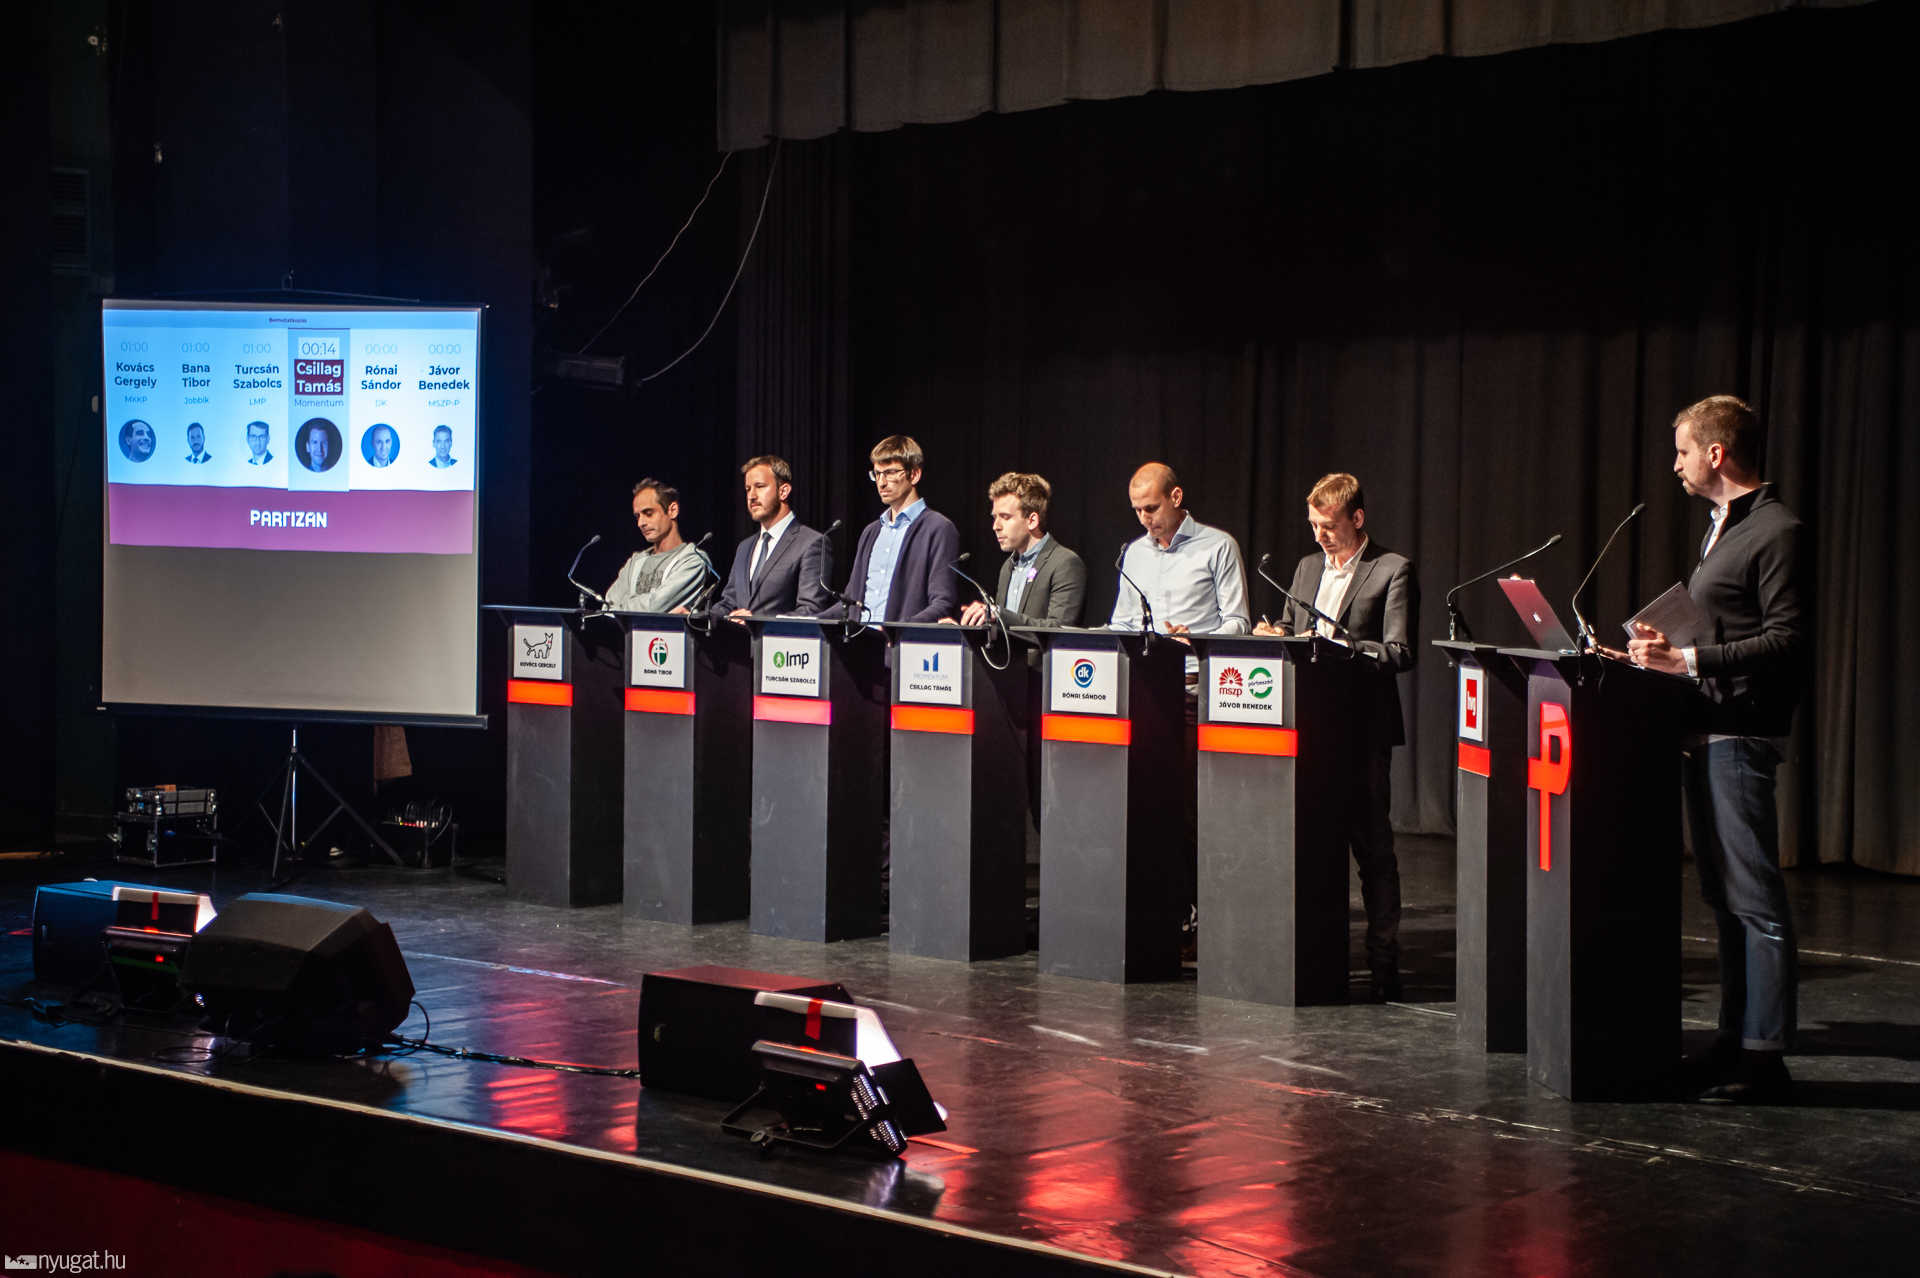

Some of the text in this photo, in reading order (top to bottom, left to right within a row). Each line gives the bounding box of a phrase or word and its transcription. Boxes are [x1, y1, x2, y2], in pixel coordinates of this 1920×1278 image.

[301, 342, 337, 355] 00:14
[116, 361, 155, 373] Kovács
[182, 363, 211, 374] Bana
[235, 363, 280, 374] Turcsán
[296, 362, 342, 378] Csillag
[365, 364, 398, 376] Rónai
[428, 365, 461, 376] Jávor
[114, 376, 157, 388] Gergely
[182, 378, 211, 388] Tibor
[233, 378, 282, 389] Szabolcs
[297, 379, 341, 393] Tamás
[361, 379, 402, 390] Sándor
[418, 380, 470, 391] Benedek
[294, 399, 344, 407] Momentum
[250, 509, 328, 528] PARTIZAN
[786, 651, 809, 669] lmp
[1077, 666, 1089, 678] dk
[1218, 687, 1243, 697] mszp
